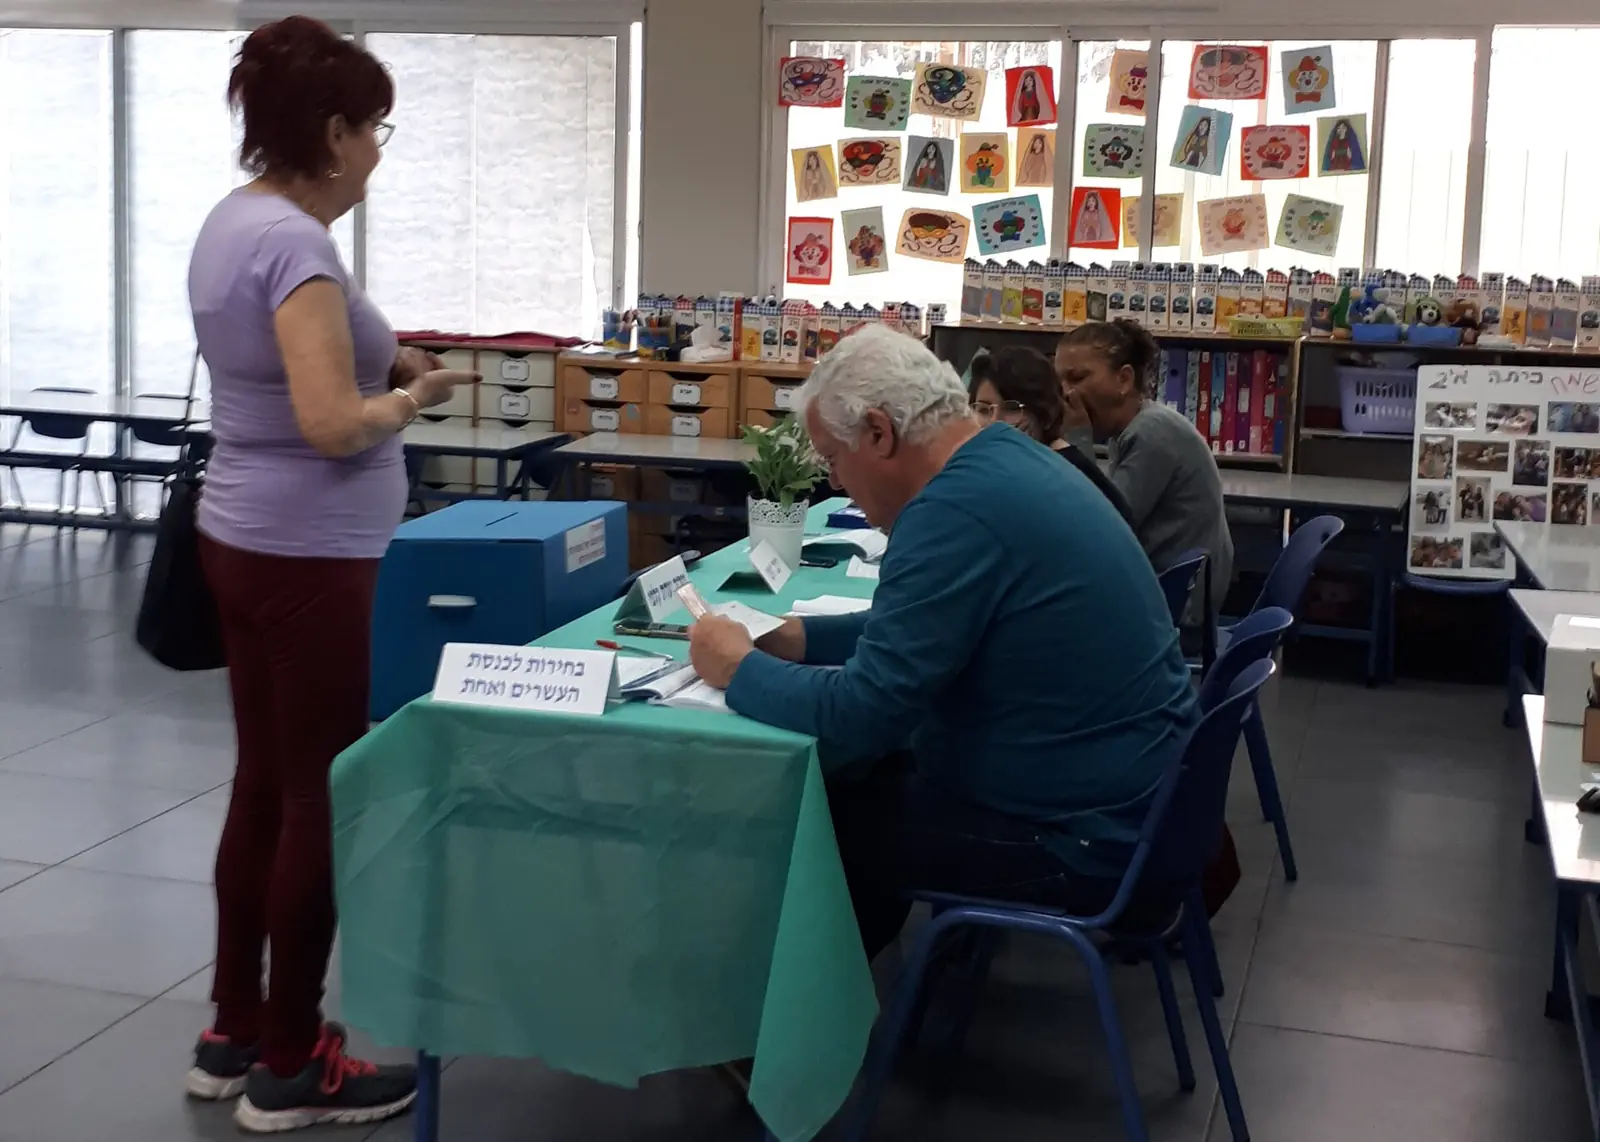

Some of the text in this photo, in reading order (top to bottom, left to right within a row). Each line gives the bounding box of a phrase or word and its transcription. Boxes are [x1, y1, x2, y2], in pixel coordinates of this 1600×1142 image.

[1488, 370, 1543, 385] כיתה
[466, 652, 585, 677] בחירות לכנסת
[460, 677, 580, 702] העשרים ואחת
